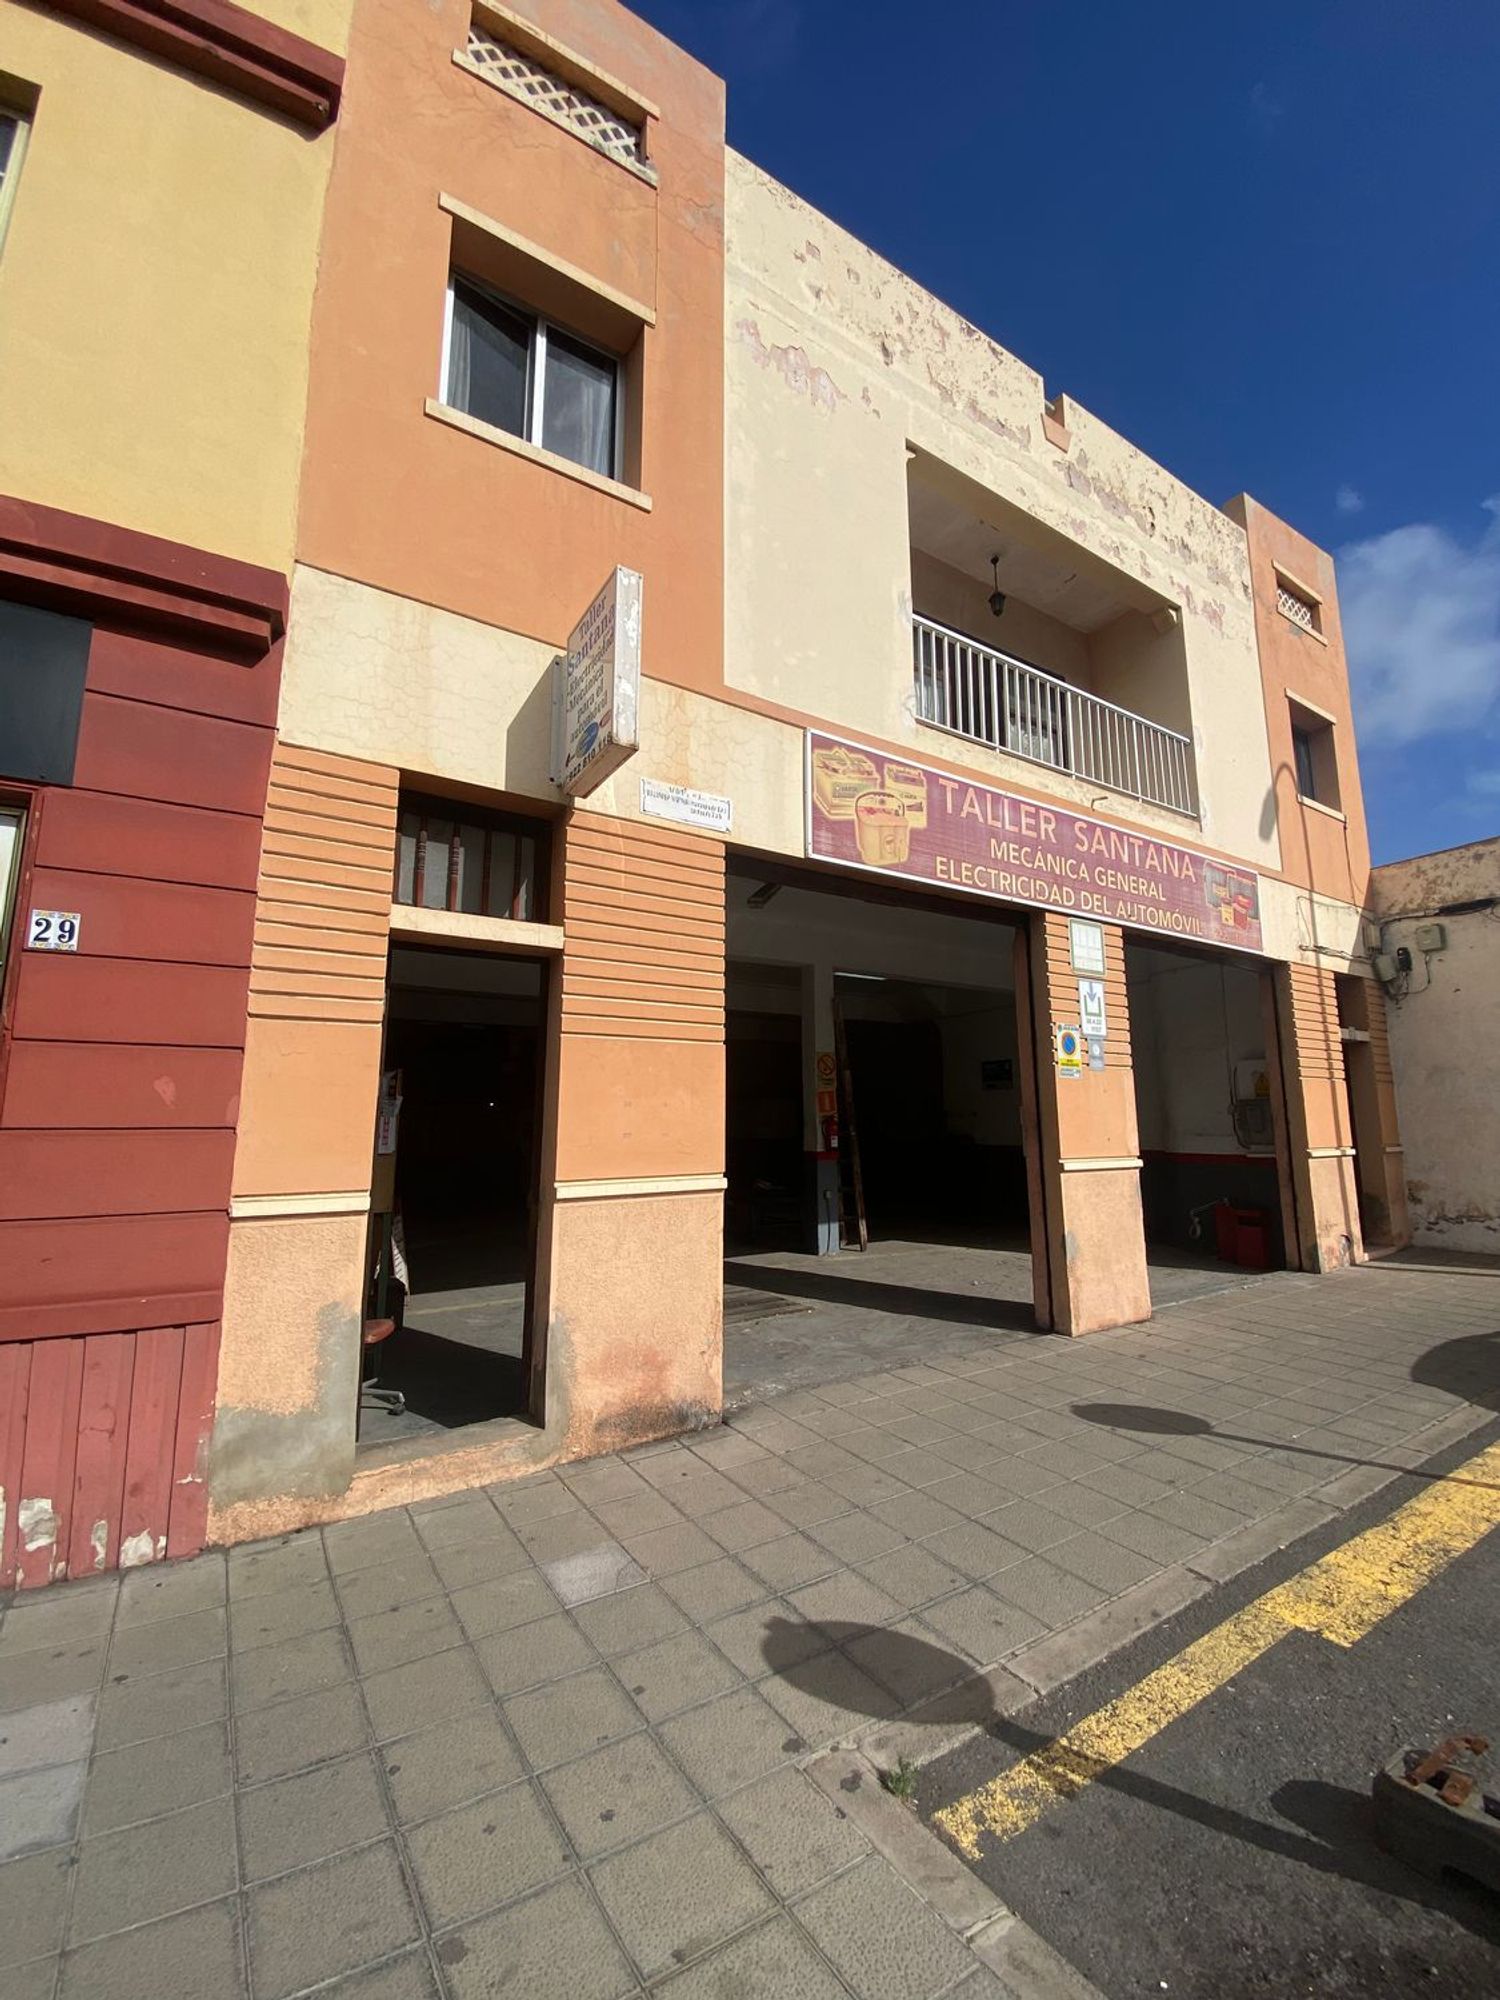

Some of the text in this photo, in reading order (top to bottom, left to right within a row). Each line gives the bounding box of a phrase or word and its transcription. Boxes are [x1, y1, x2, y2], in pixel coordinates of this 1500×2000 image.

[567, 603, 615, 677] Santana
[579, 595, 606, 640] Taller
[938, 777, 1196, 883] TALLER SANTANA
[936, 855, 1075, 907] ELECTRICIDAD
[1081, 891, 1112, 915] DEL
[1116, 900, 1203, 935] AUTOMÓVIL
[990, 837, 1167, 901] MECÁNICA GENERAL
[33, 917, 76, 944] 29
